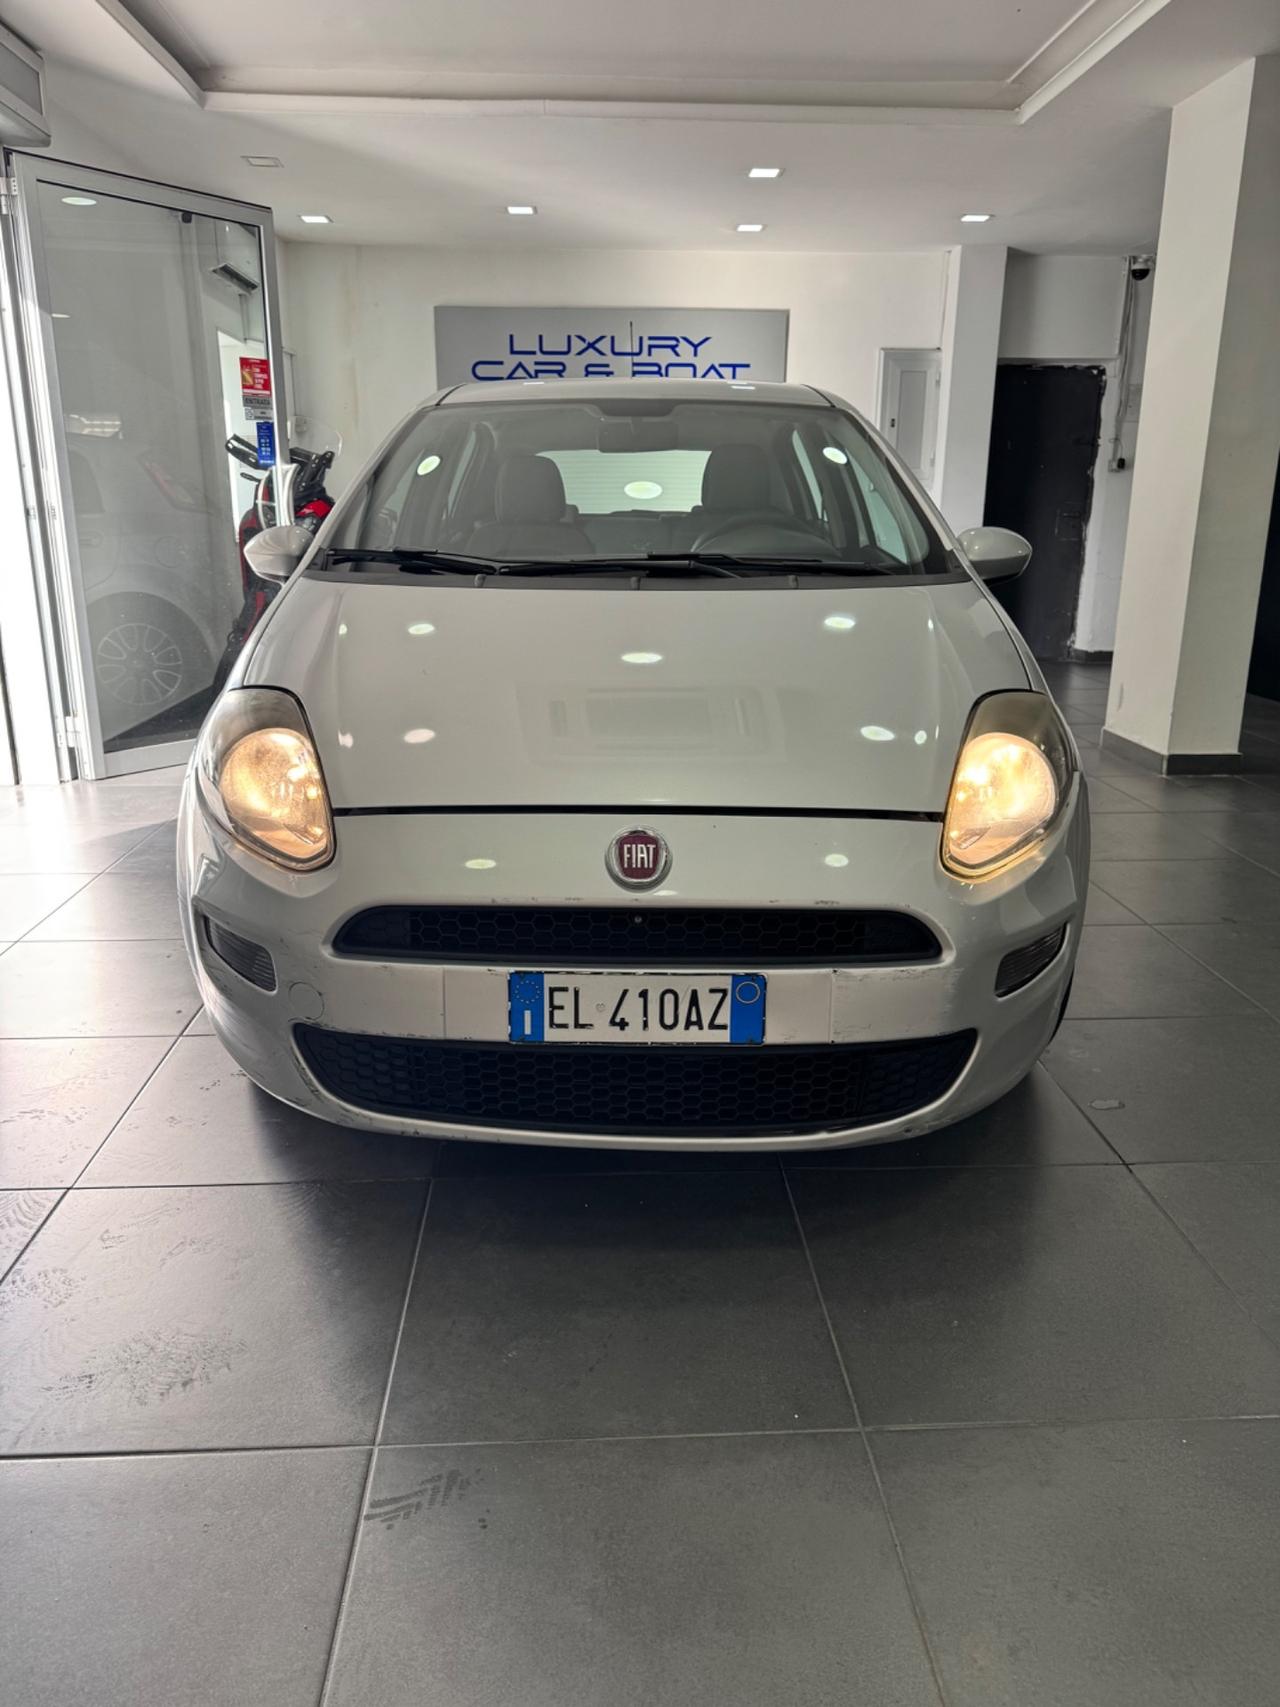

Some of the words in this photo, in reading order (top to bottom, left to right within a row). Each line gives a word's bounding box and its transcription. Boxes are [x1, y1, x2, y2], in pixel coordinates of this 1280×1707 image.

[508, 334, 712, 357] LUXURY
[471, 360, 566, 381] CAR
[623, 843, 657, 869] FIAT
[547, 986, 594, 1029] EL
[609, 987, 729, 1031] 410AZ
